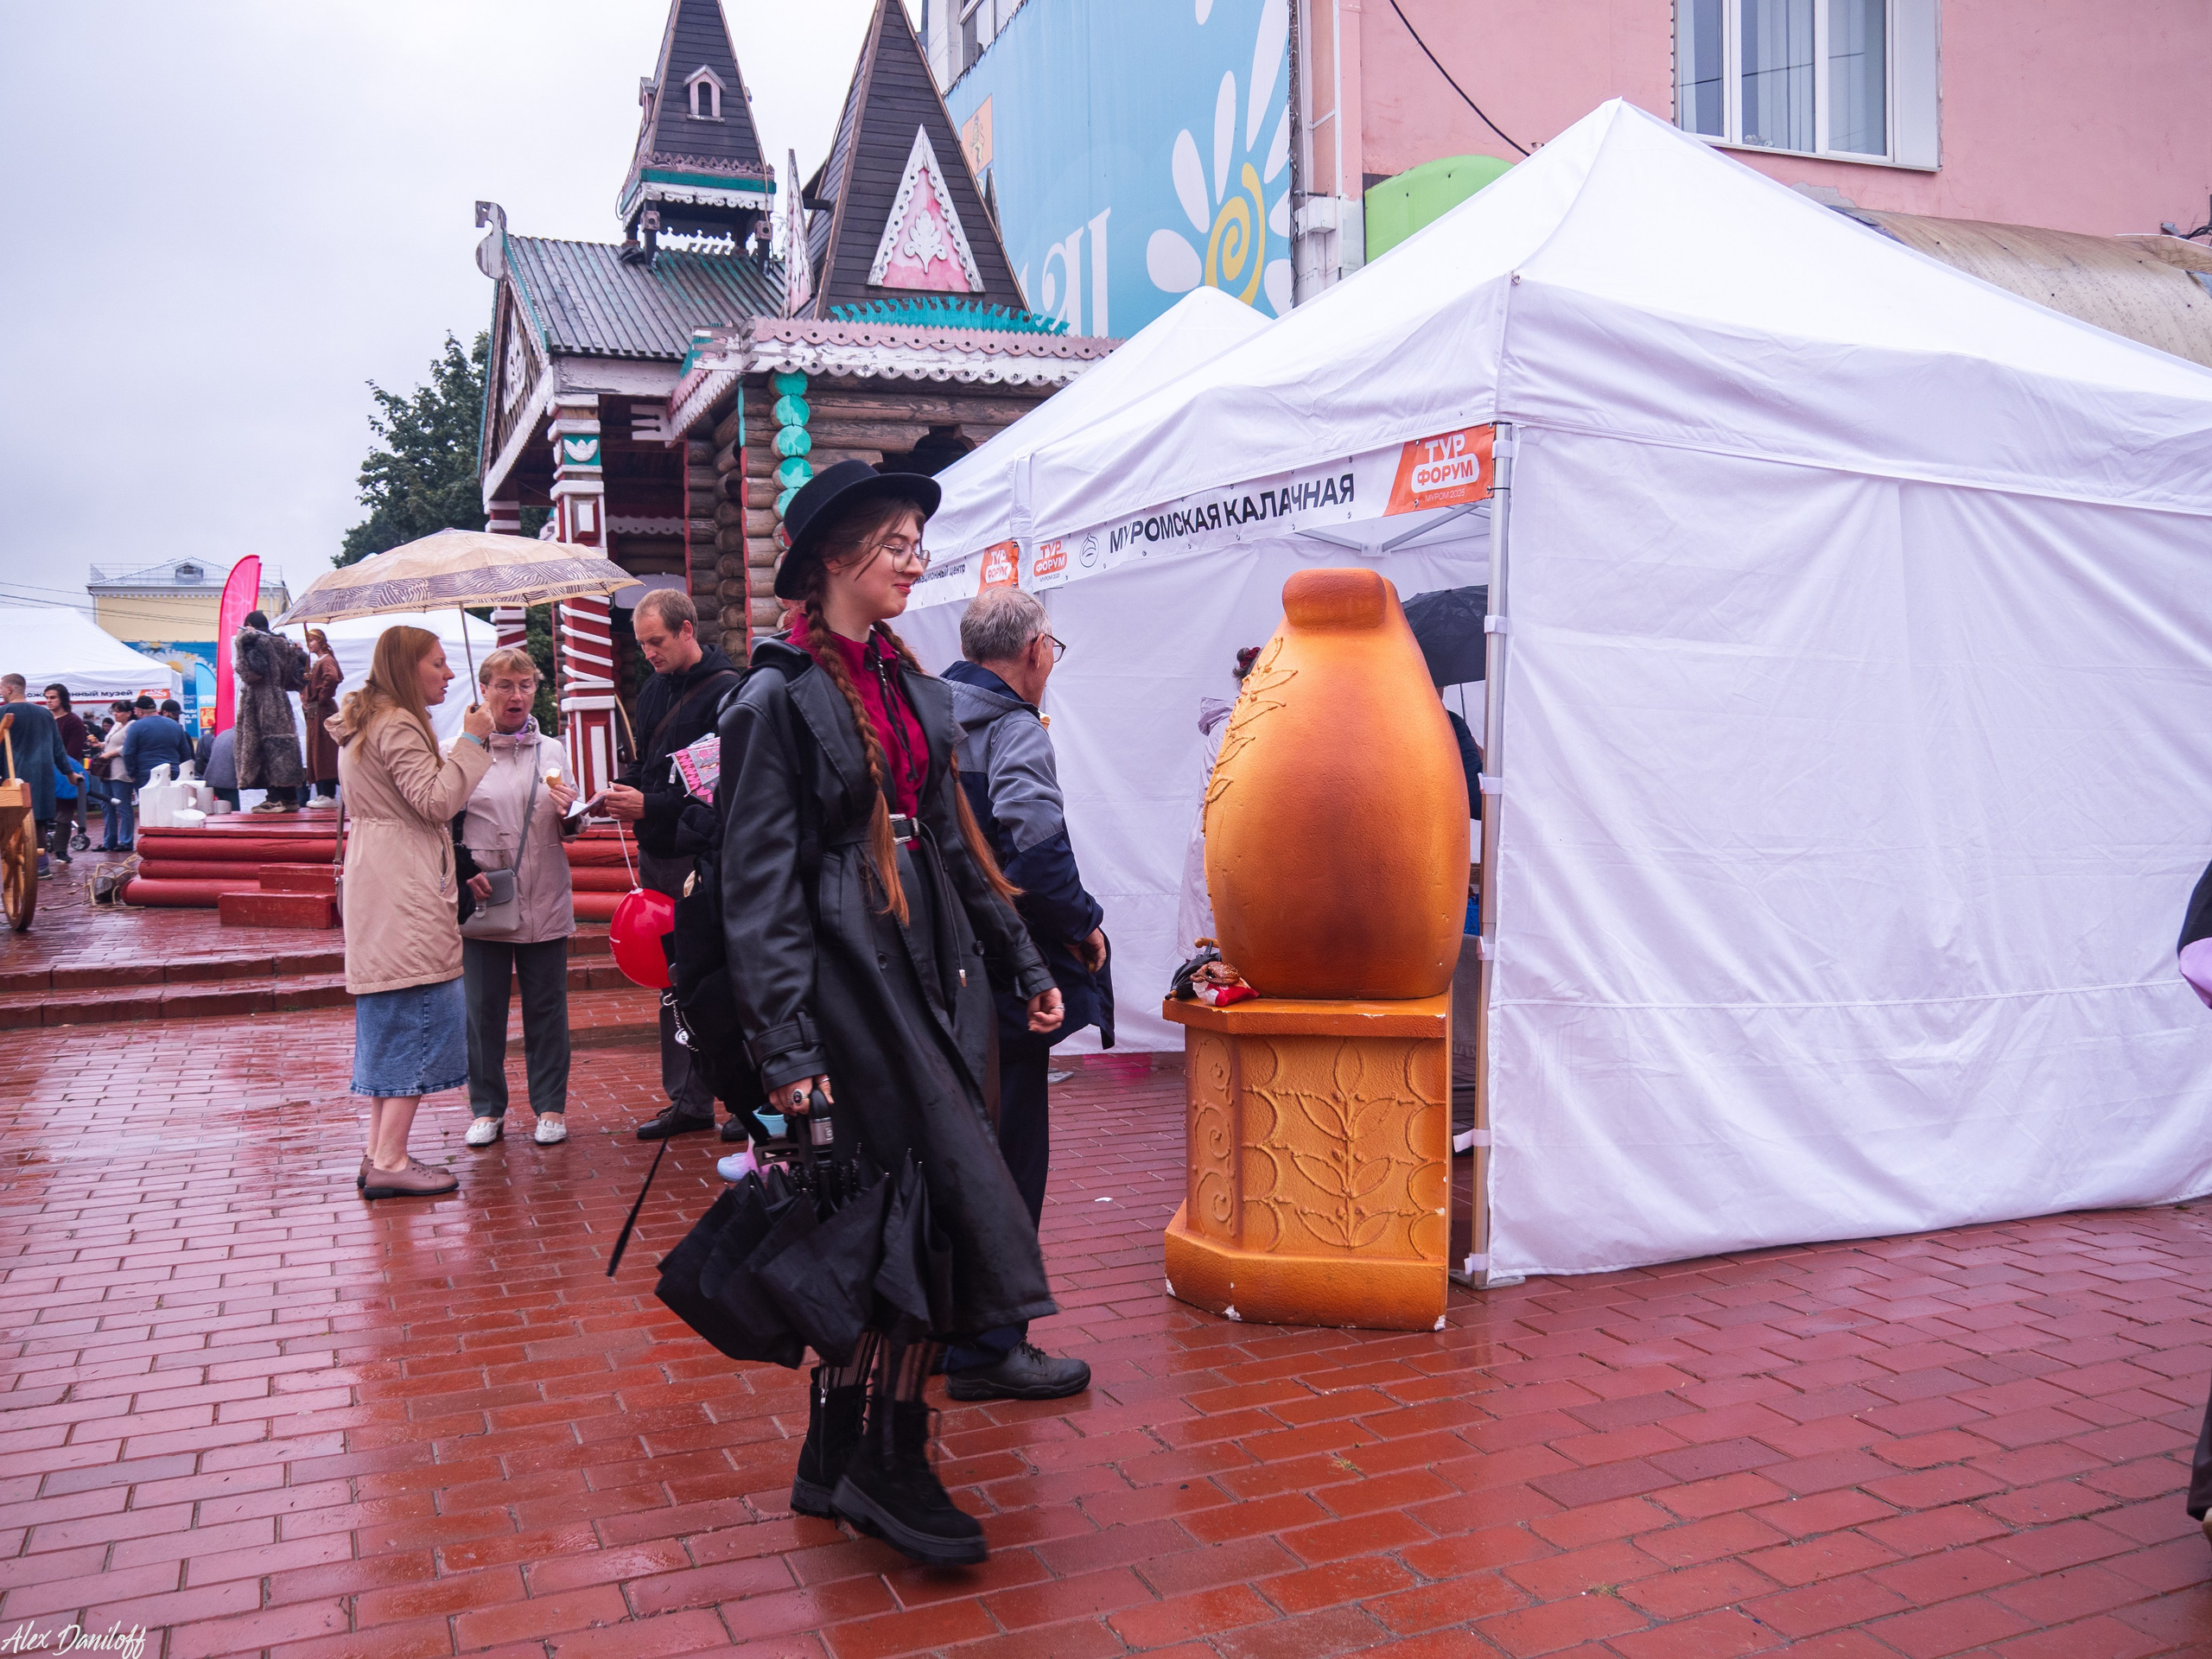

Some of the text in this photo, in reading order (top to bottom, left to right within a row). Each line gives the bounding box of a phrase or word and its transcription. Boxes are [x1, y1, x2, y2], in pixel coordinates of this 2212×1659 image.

[1425, 434, 1466, 463] ТУР
[1417, 460, 1473, 486] ФОРУМ
[1109, 473, 1355, 554] МУРОМСКАЯ КАЛАЧНАЯ
[1040, 541, 1061, 559] ТУР
[1036, 555, 1065, 572] ФОРУМ
[100, 689, 133, 697] музей
